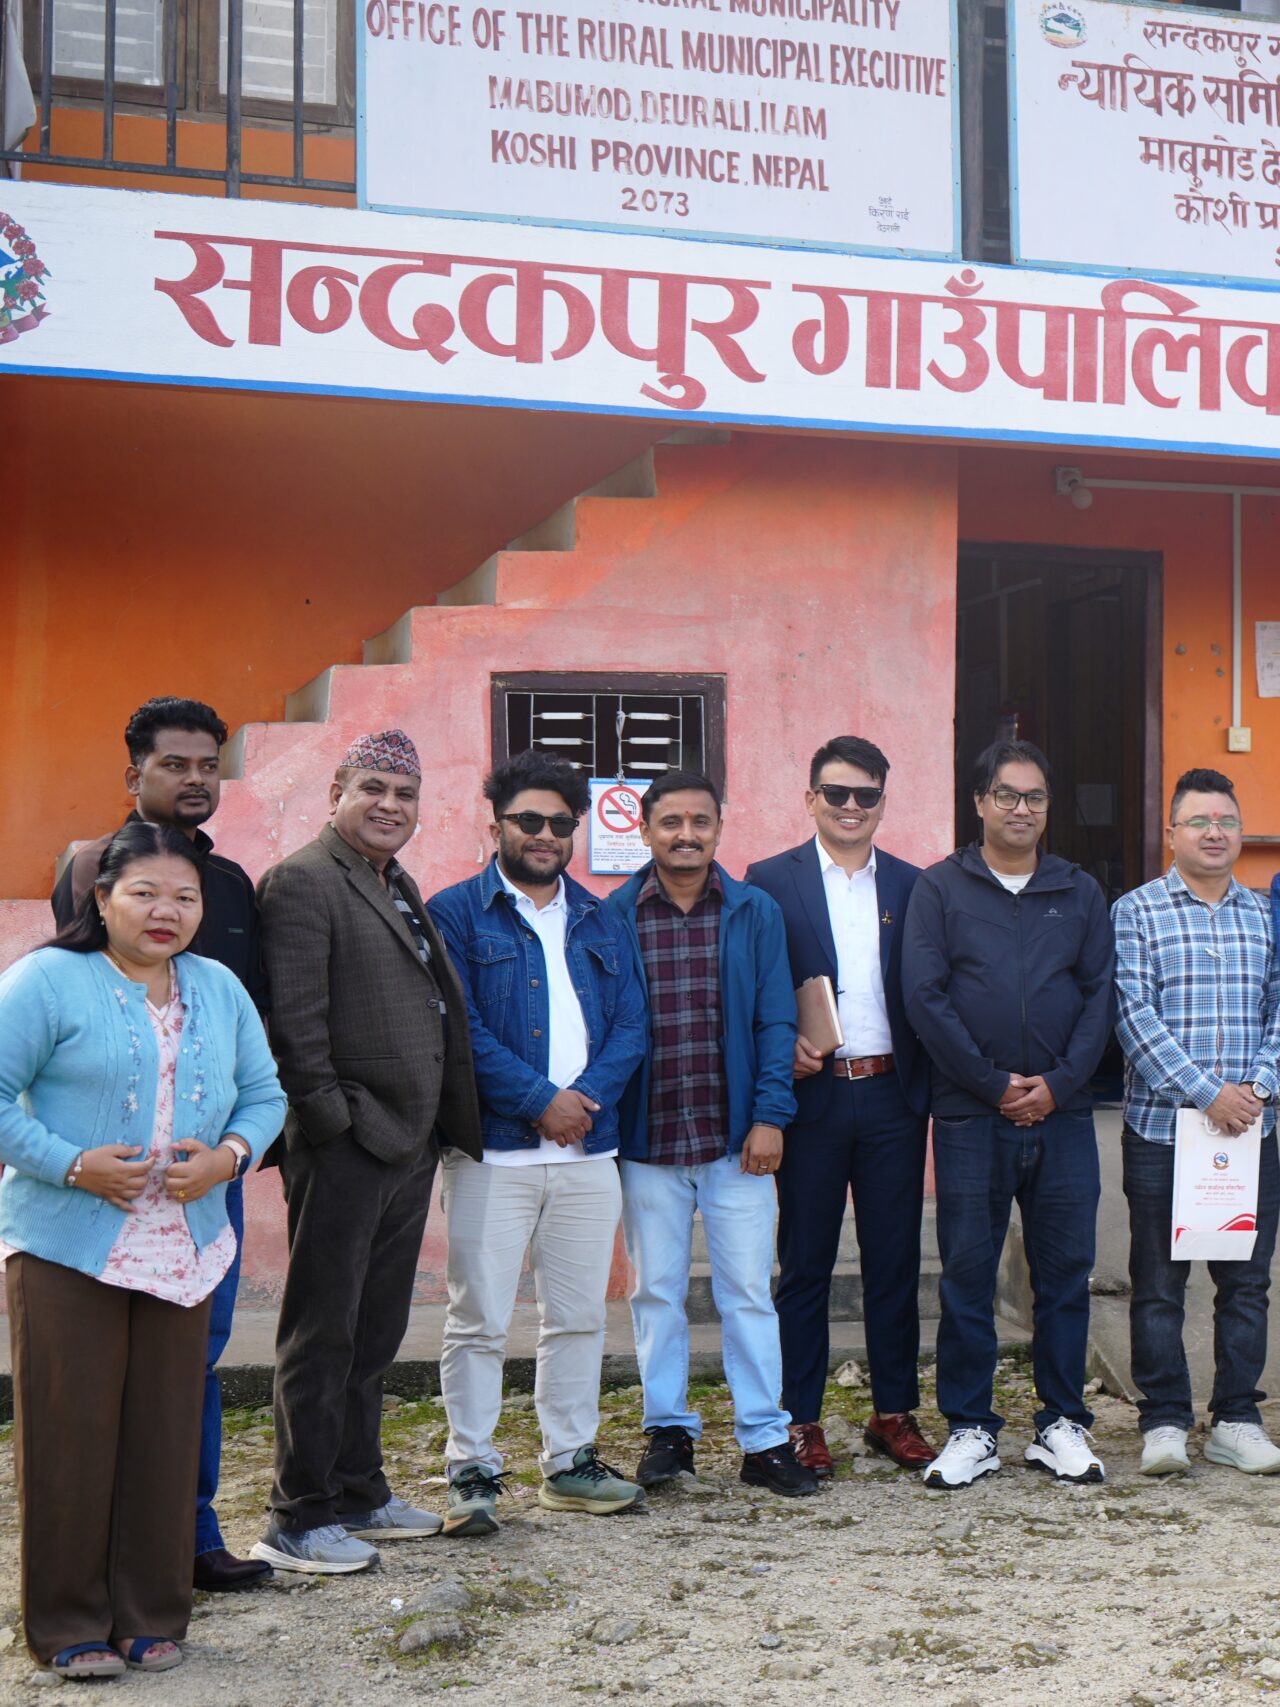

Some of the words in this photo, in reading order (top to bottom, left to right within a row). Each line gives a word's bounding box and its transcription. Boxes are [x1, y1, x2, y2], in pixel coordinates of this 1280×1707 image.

[366, 0, 462, 46] OFFICE
[472, 7, 506, 51] OF
[516, 11, 571, 58] THE
[578, 18, 674, 69] RURAL
[681, 29, 825, 84] MUNICIPAL
[829, 44, 947, 97] EXECUTIVE
[1142, 20, 1260, 66] सन्दकपुर
[1058, 53, 1197, 118] न्यायिक
[490, 129, 577, 170] KOSHI
[620, 187, 690, 217] 2073
[1173, 187, 1251, 236] कोशी
[153, 229, 772, 412] सन्दकपुर
